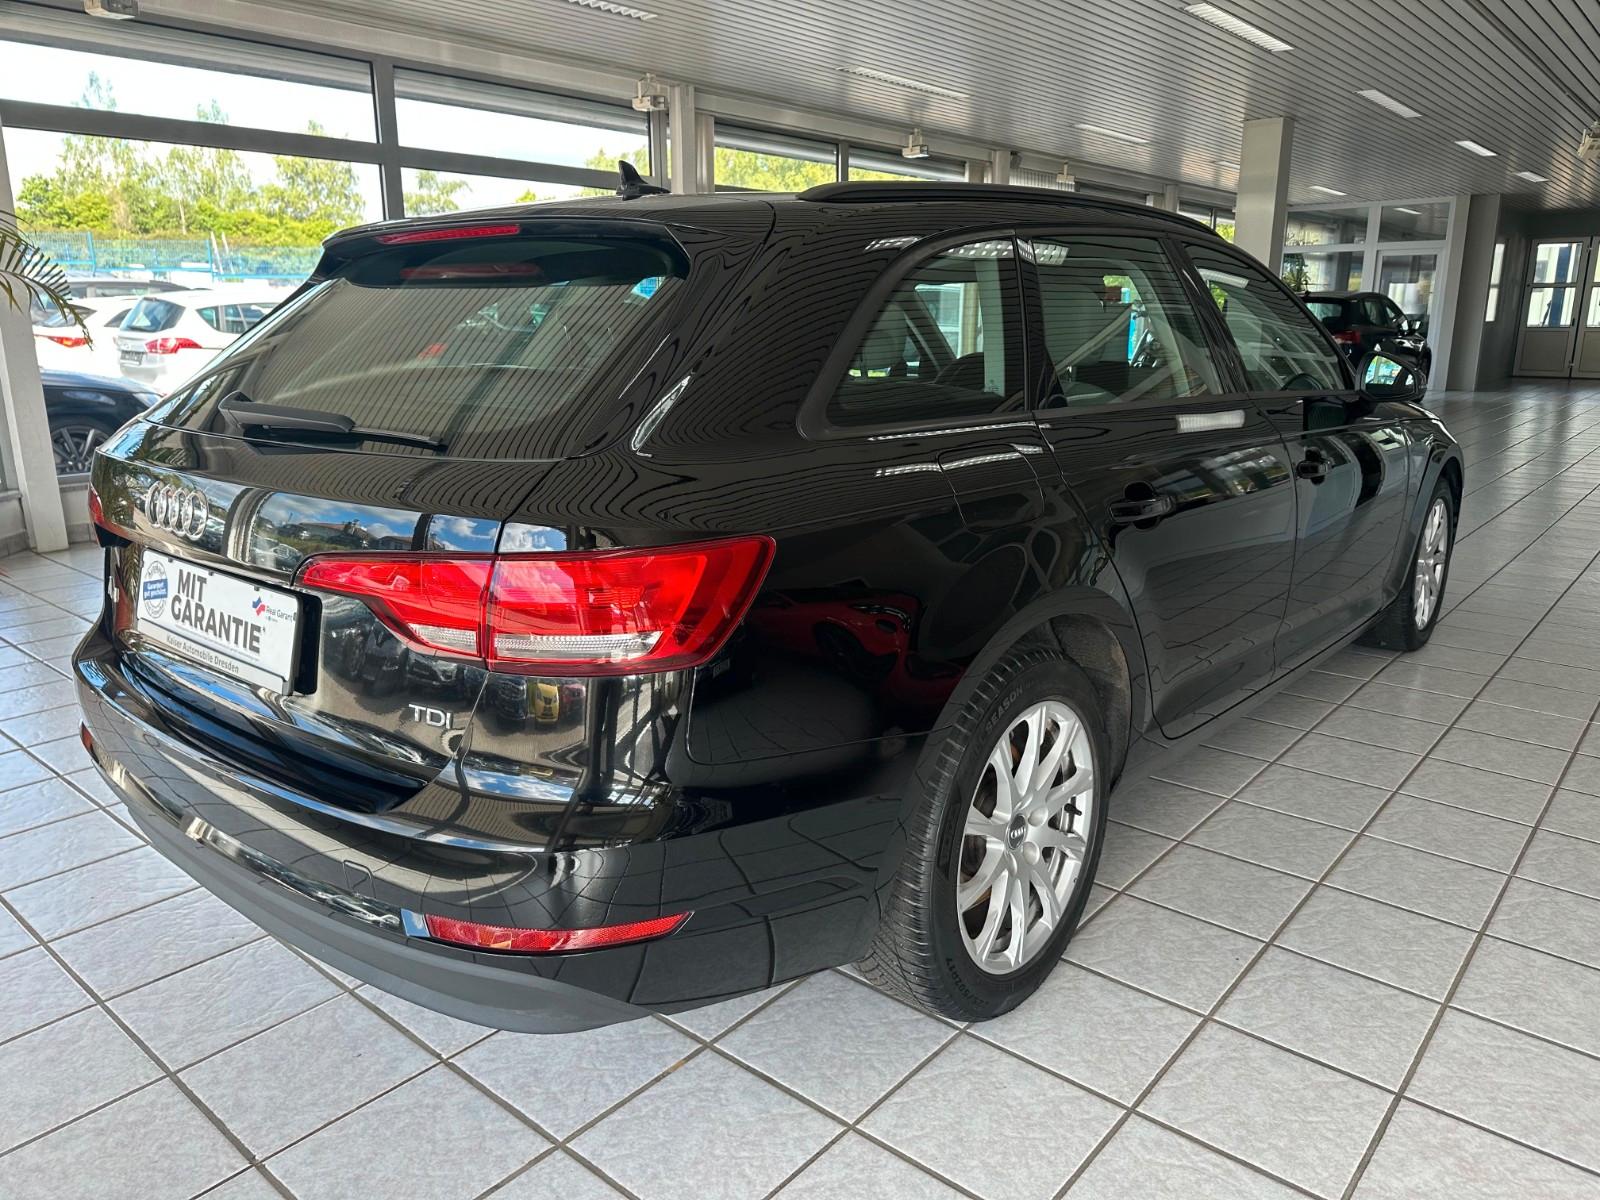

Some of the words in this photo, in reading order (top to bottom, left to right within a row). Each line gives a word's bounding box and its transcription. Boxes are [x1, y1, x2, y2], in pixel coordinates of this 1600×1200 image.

[177, 569, 207, 602] MIT
[182, 641, 214, 663] Automobile
[214, 654, 240, 674] Dresden
[408, 703, 451, 730] TDI
